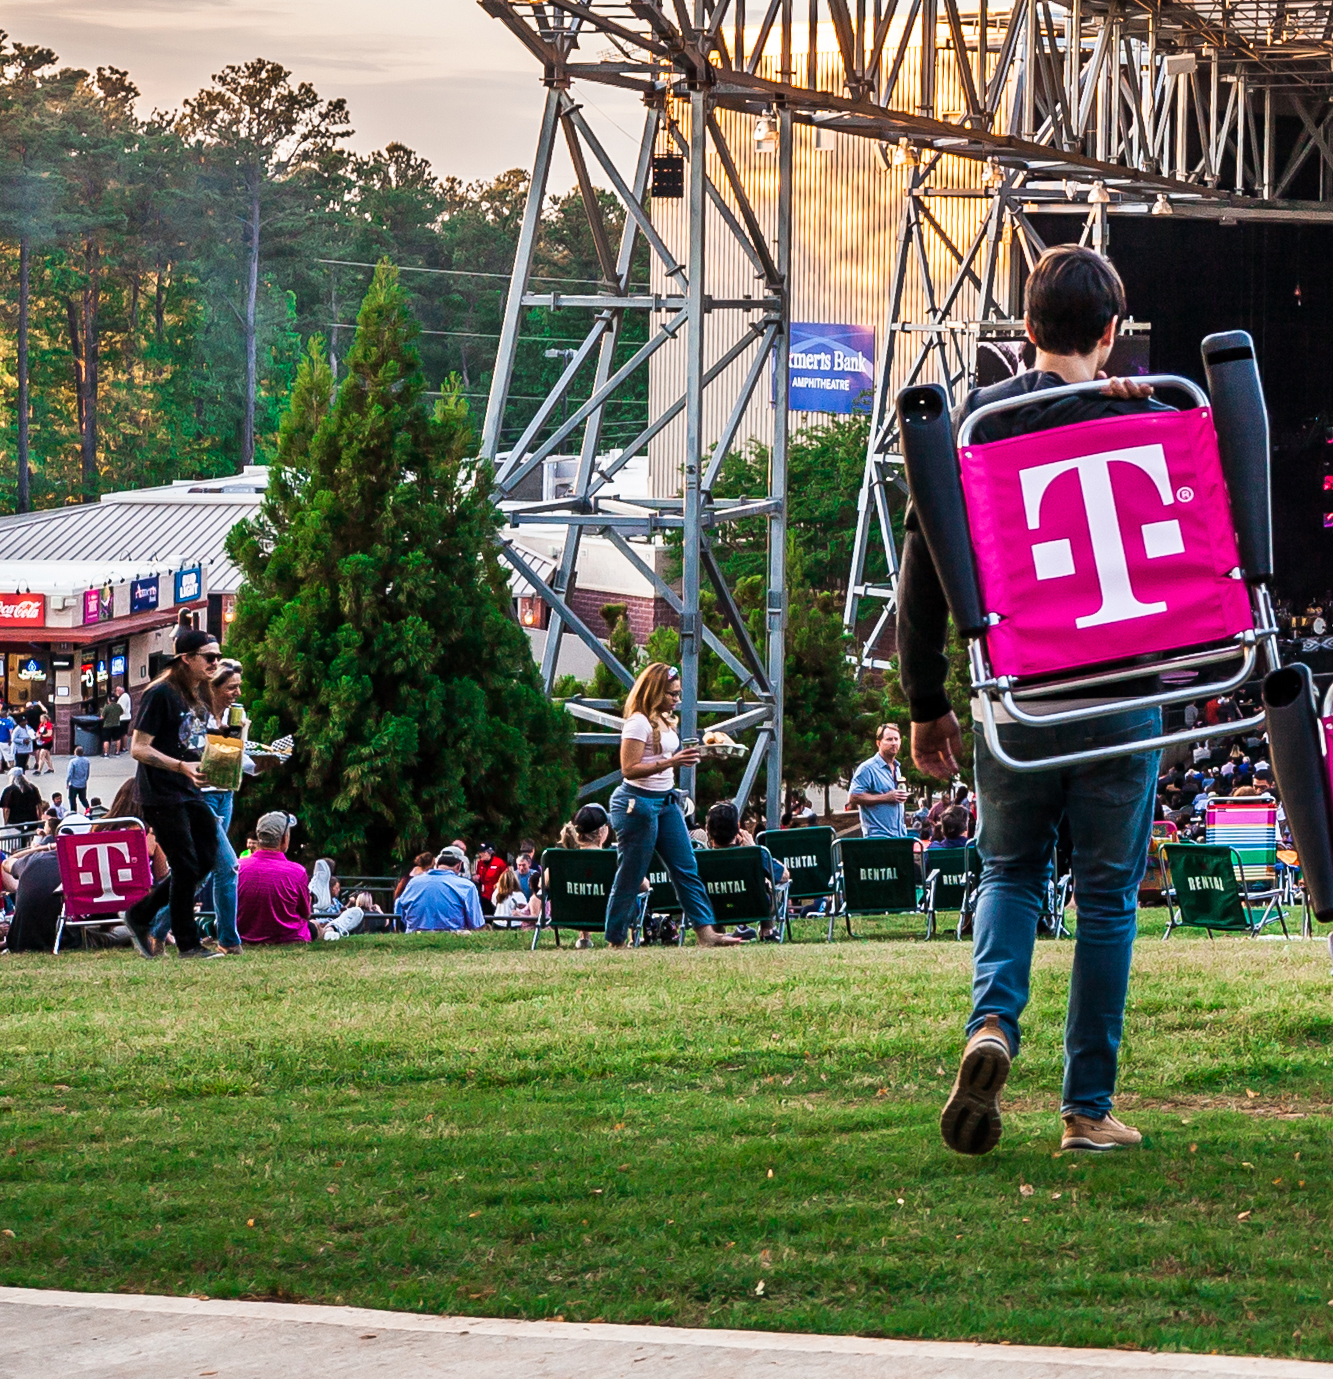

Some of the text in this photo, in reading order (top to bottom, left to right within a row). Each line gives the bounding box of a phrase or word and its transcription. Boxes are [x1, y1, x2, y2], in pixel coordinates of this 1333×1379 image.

[834, 351, 867, 373] Bank
[792, 377, 850, 391] AMPHITHEATRE
[1019, 443, 1185, 629] T
[784, 855, 818, 869] RENTAL
[76, 842, 133, 902] T
[650, 872, 671, 884] REN
[860, 867, 898, 880] RENTAL
[943, 874, 962, 885] RENT
[1188, 876, 1224, 891] RENTAL
[566, 881, 605, 896] RENTAL
[707, 880, 747, 894] RENTAL
